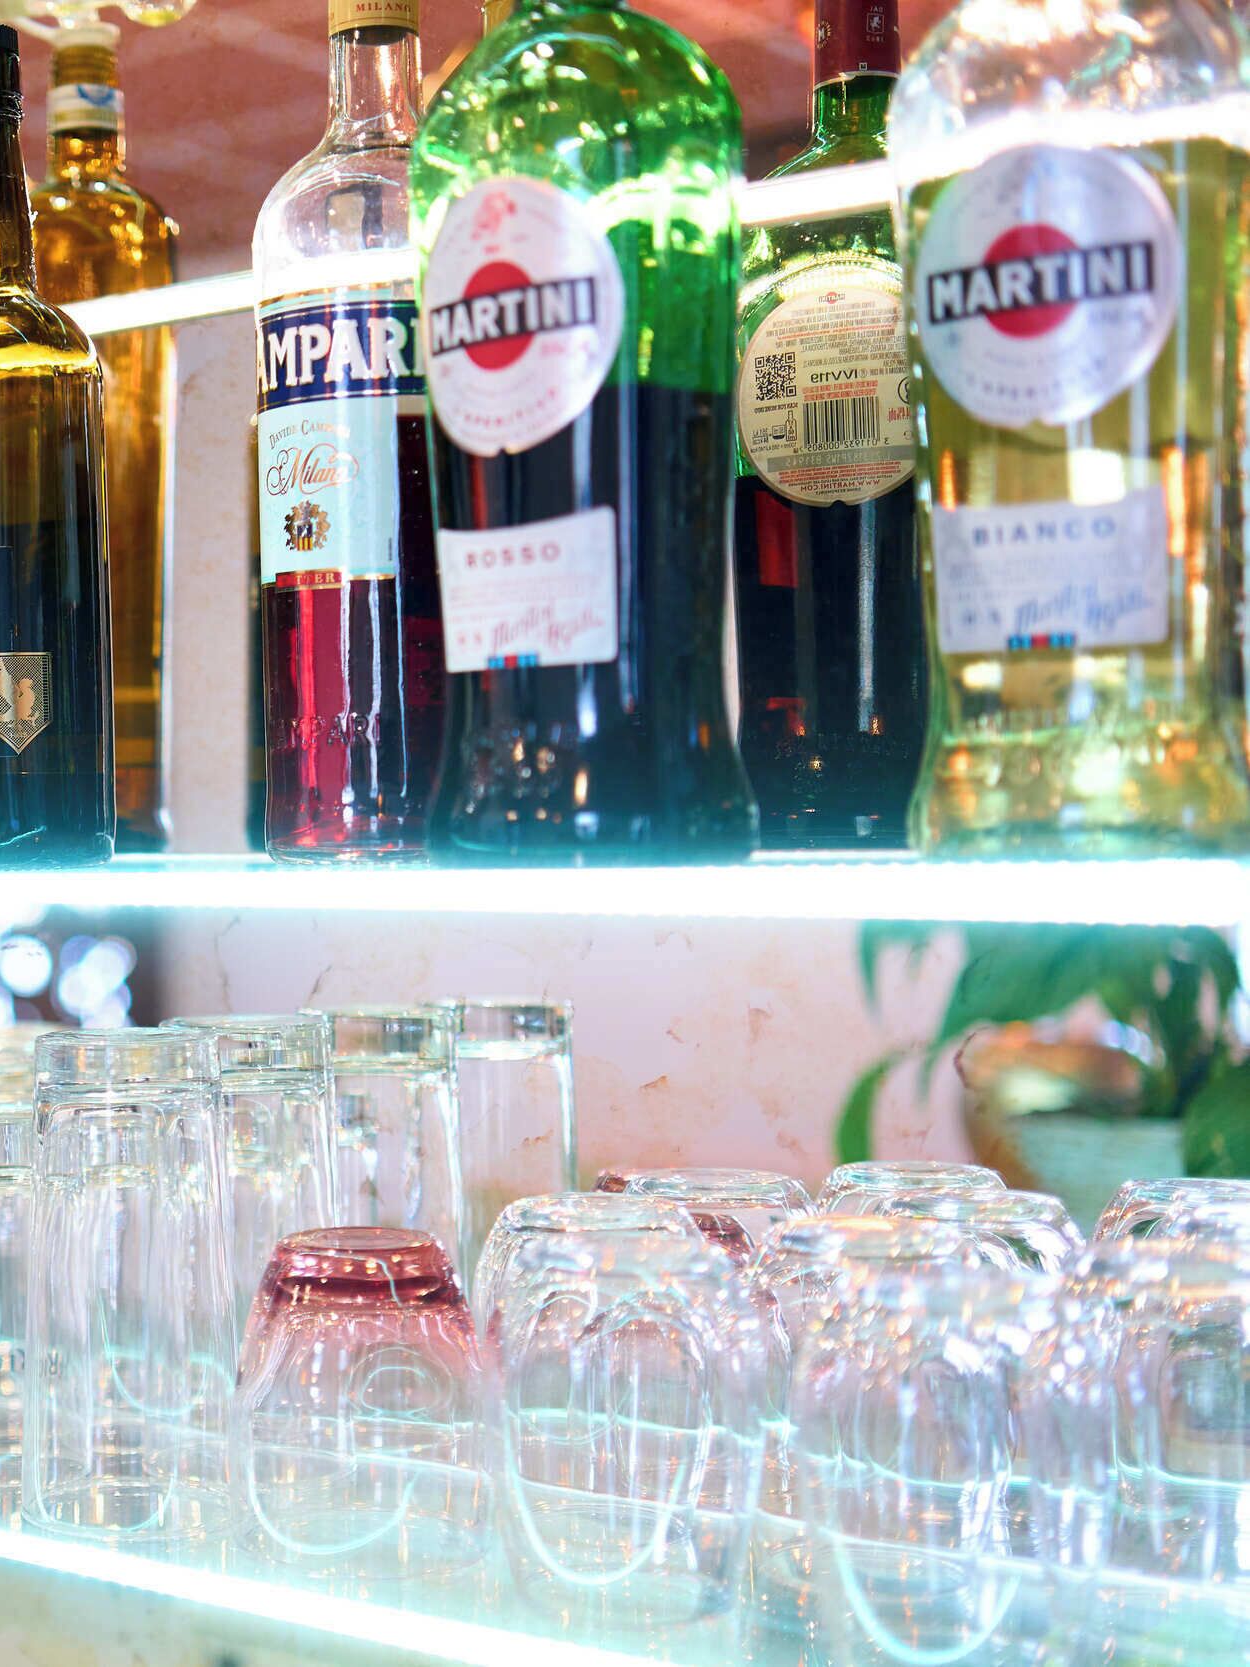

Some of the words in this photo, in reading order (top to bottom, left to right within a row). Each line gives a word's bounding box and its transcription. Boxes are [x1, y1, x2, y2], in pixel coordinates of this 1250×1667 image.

[930, 247, 1148, 320] MARTINI
[431, 279, 593, 354] MARTINI
[465, 541, 561, 568] ROSSO
[972, 515, 1117, 548] BIANCO
